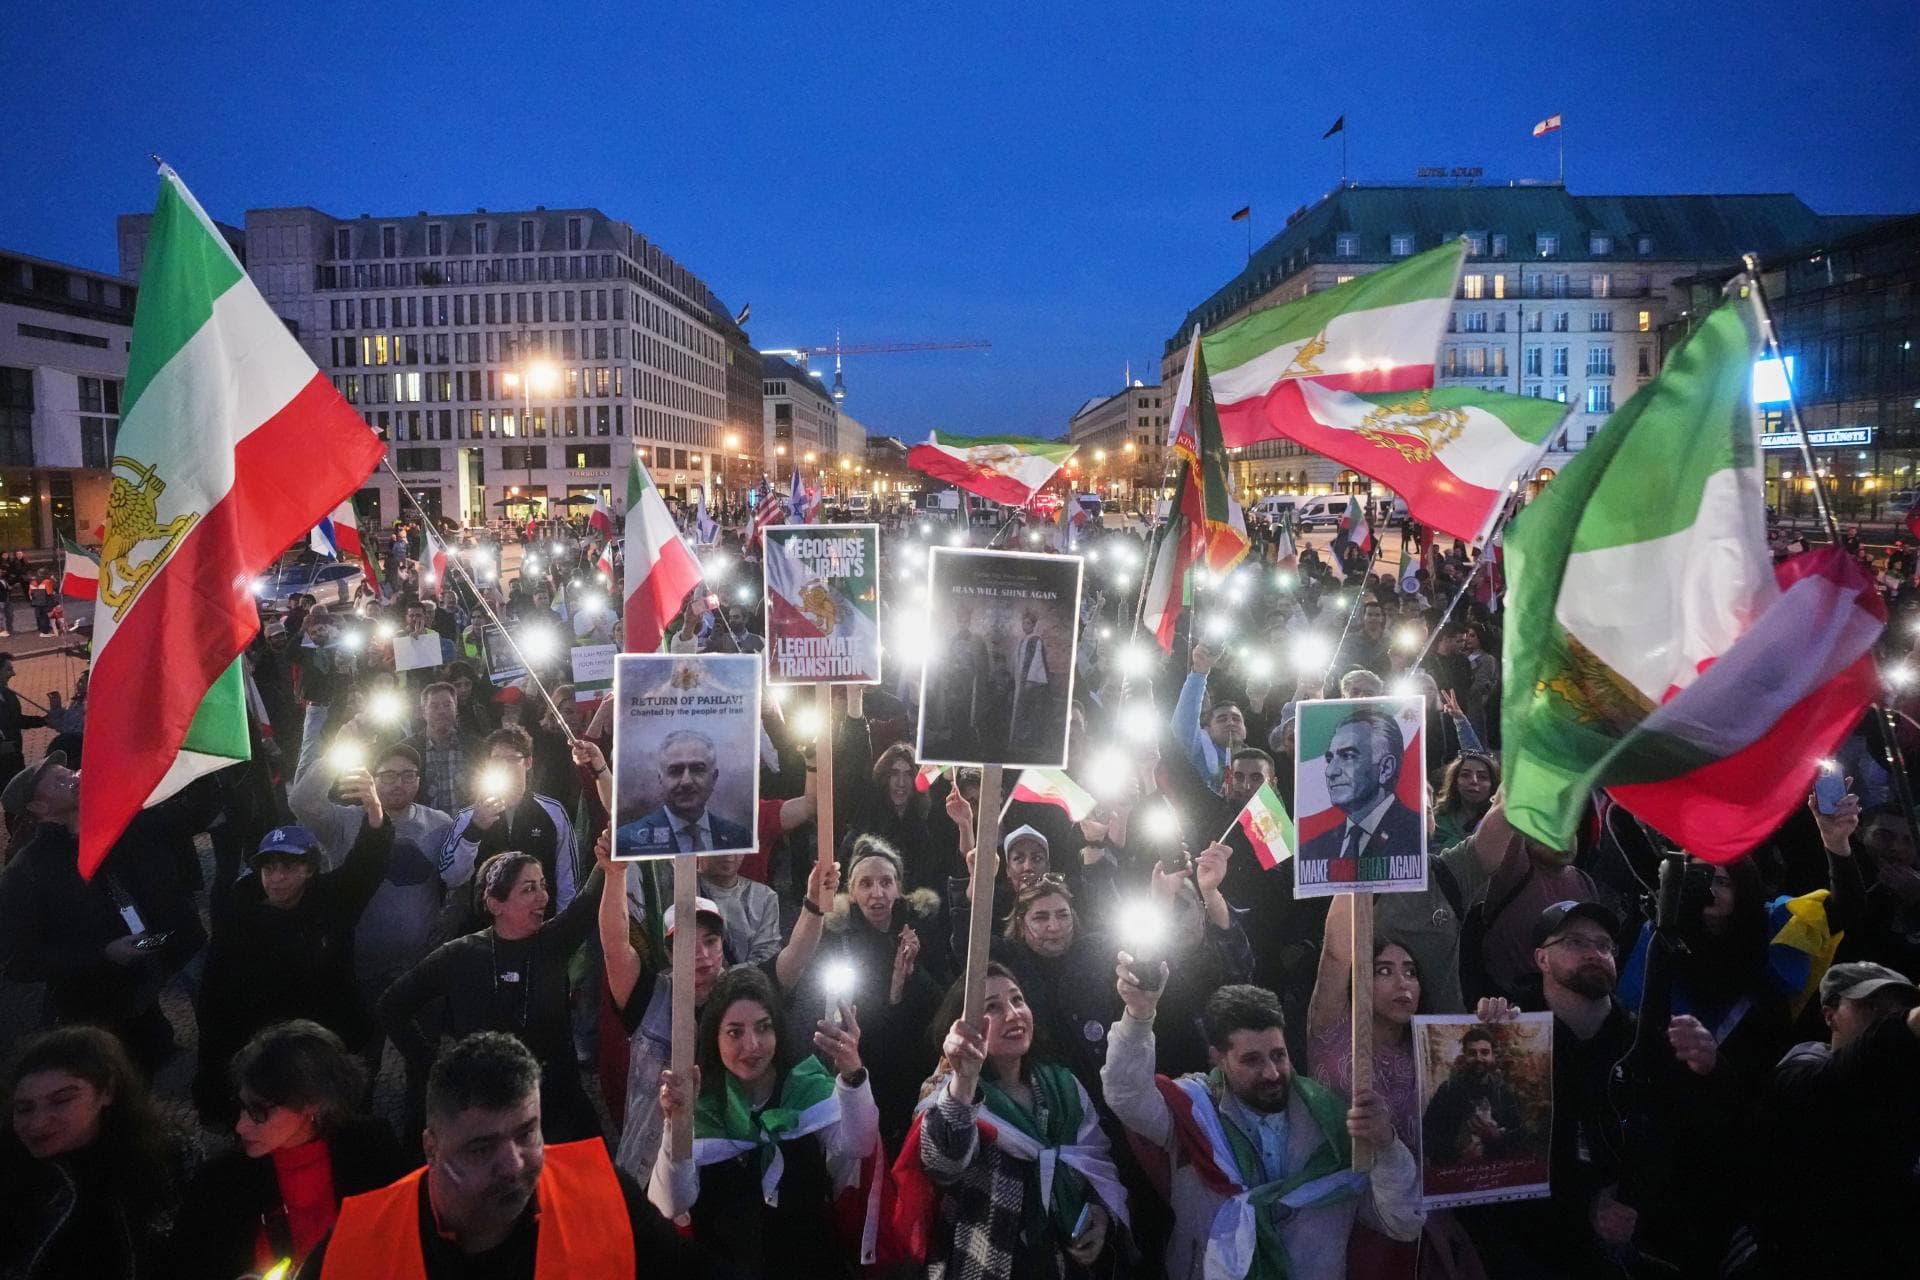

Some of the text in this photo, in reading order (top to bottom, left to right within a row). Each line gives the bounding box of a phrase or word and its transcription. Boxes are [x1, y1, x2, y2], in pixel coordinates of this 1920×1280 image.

[784, 538, 865, 558] RECOGNISE
[816, 558, 864, 577] IRAN'S
[952, 585, 1057, 600] IRAN WILL SHINE AGAIN
[778, 637, 863, 657] LEGITIMATE
[778, 656, 863, 677] TRANSITION
[631, 696, 743, 706] RETURN OF PAHLAVI
[630, 708, 663, 716] Chanted
[665, 709, 674, 717] by
[691, 708, 717, 716] people
[1300, 858, 1329, 884] MAKE
[1358, 856, 1388, 881] GREAT
[1389, 855, 1421, 879] AGAIN
